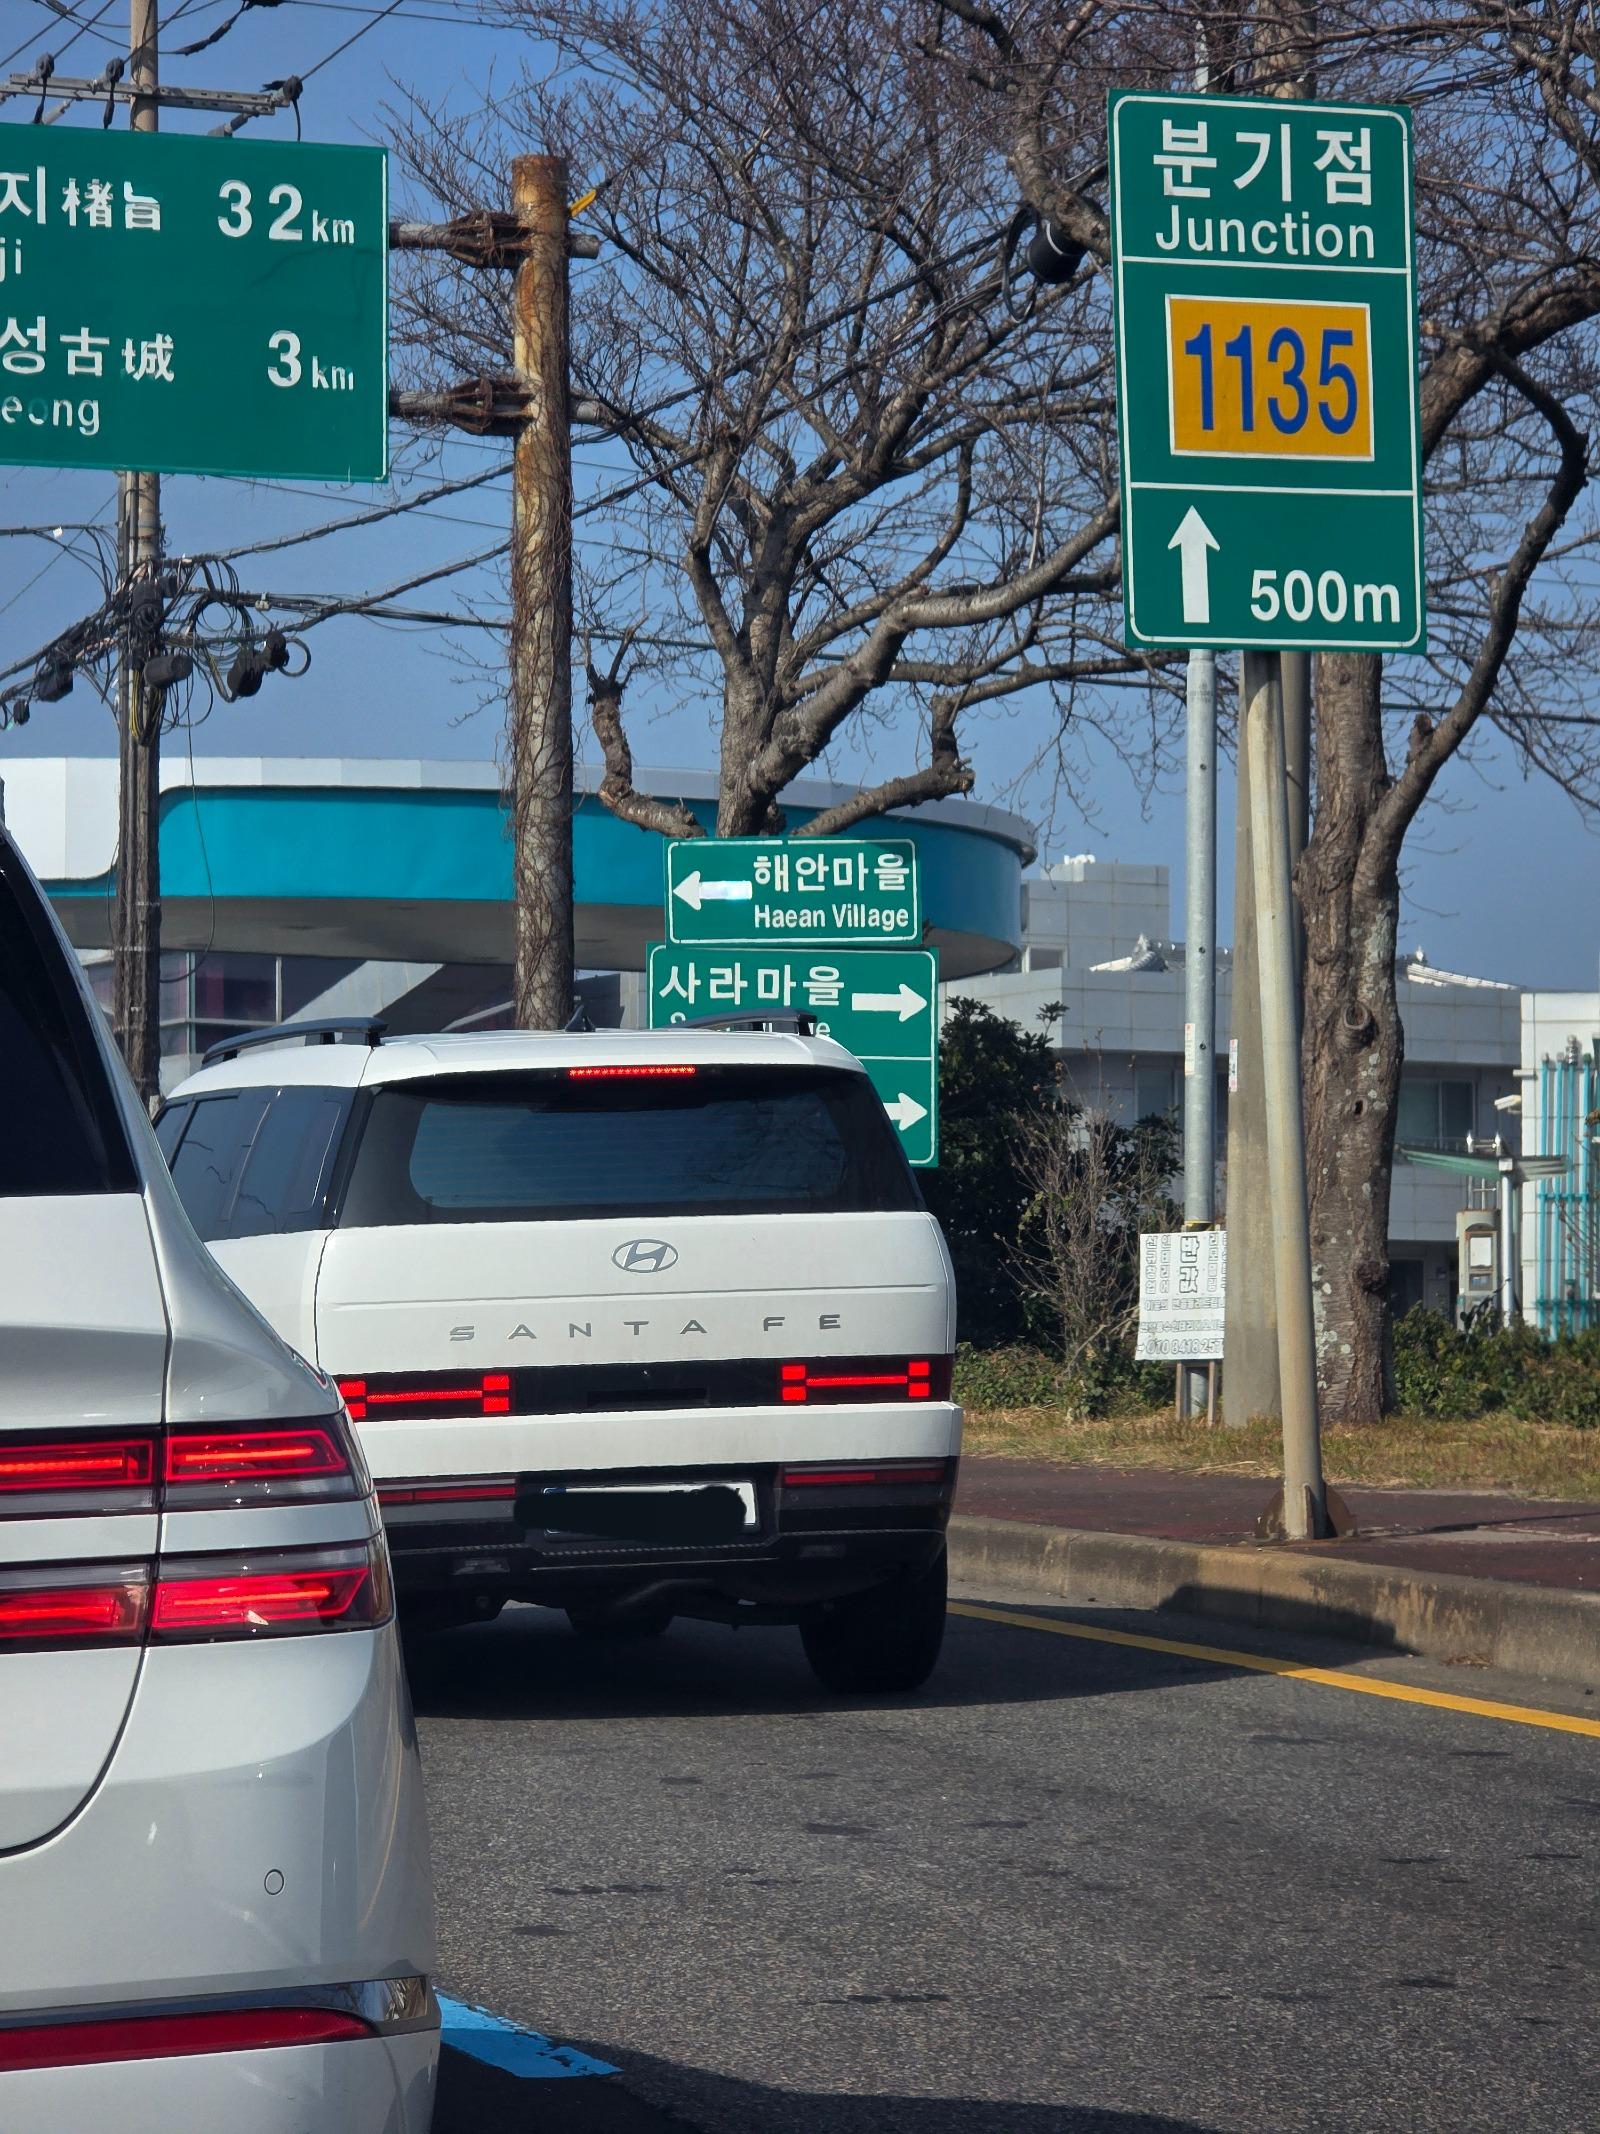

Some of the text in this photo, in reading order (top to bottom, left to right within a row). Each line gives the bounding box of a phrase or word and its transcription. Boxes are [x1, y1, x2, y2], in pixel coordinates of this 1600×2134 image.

[1153, 118, 1372, 206] 분기점
[1155, 204, 1375, 259] Junction
[1184, 323, 1359, 435] 1135
[1250, 569, 1401, 624] 500m
[753, 853, 910, 892] 해안마을
[754, 903, 909, 931] Haean Village
[659, 962, 845, 1006] 사라마을
[449, 1313, 841, 1341] SANTA FE
